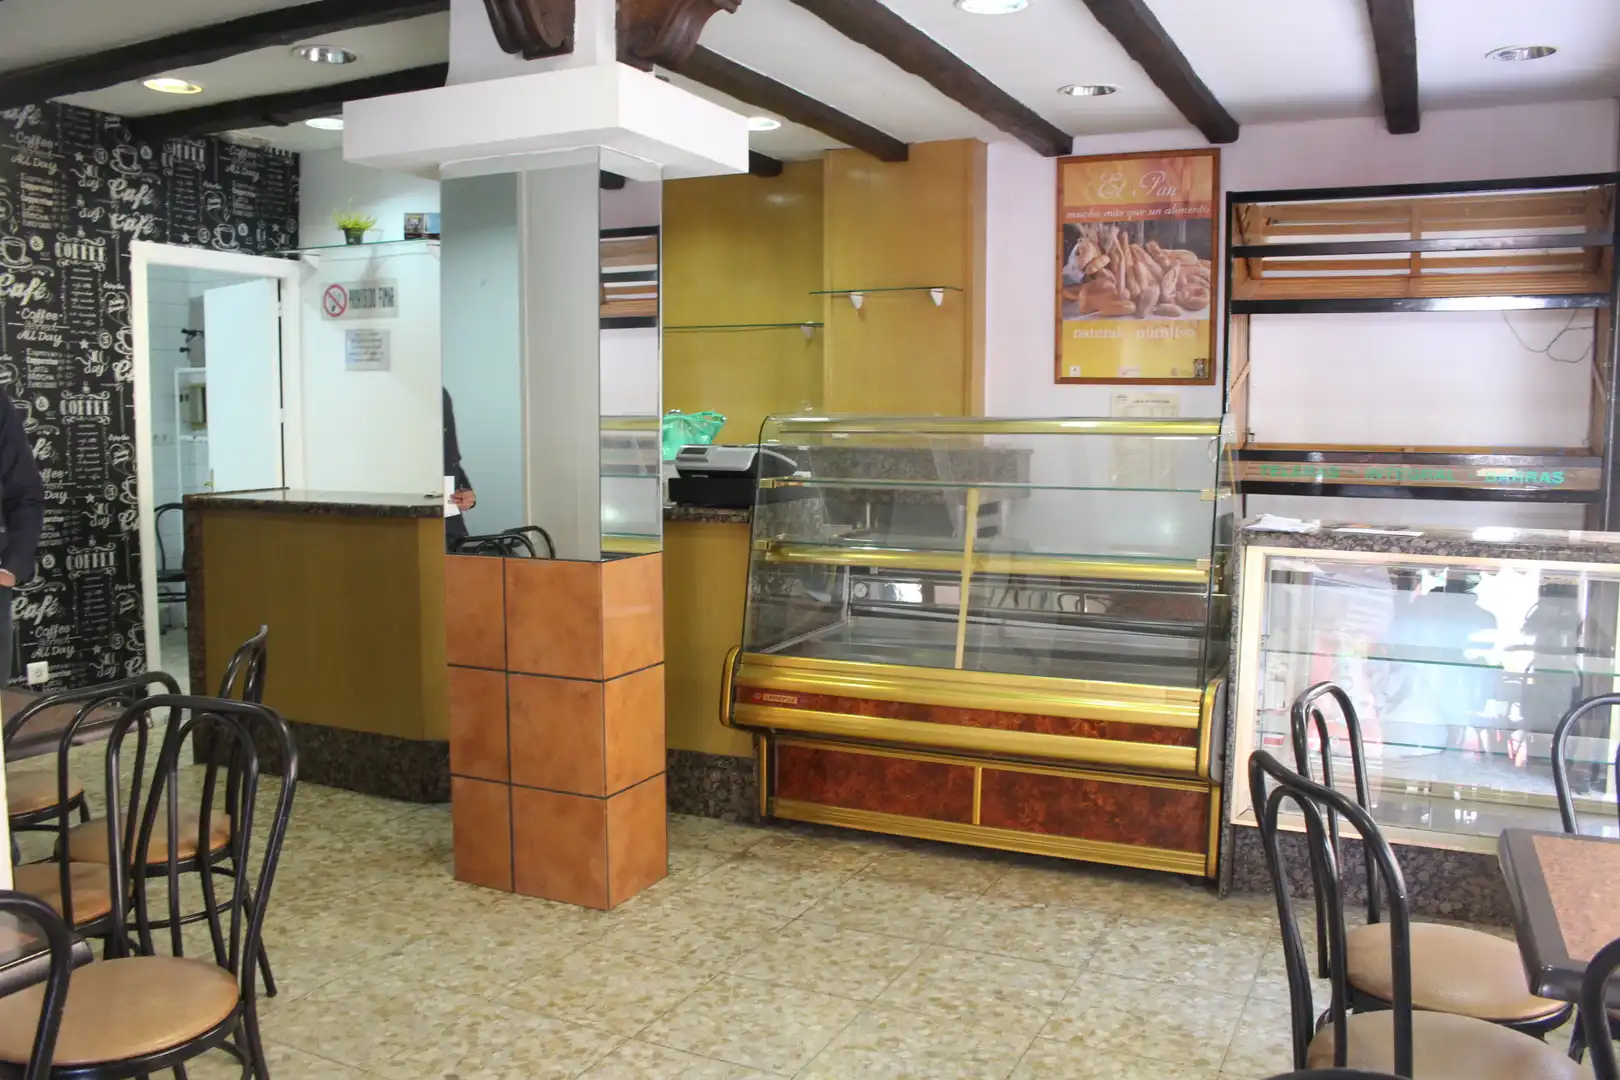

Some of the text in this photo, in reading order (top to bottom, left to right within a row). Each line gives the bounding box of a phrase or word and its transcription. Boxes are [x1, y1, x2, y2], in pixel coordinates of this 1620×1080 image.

[1138, 170, 1178, 198] Pan
[1066, 209, 1101, 219] mucho
[1127, 210, 1146, 221] que
[1163, 203, 1211, 216] alimento
[20, 307, 60, 324] Coffee
[39, 331, 63, 347] Day
[43, 490, 69, 505] Day
[11, 595, 61, 626] Café
[34, 624, 71, 642] Coffee
[53, 643, 76, 658] Day
